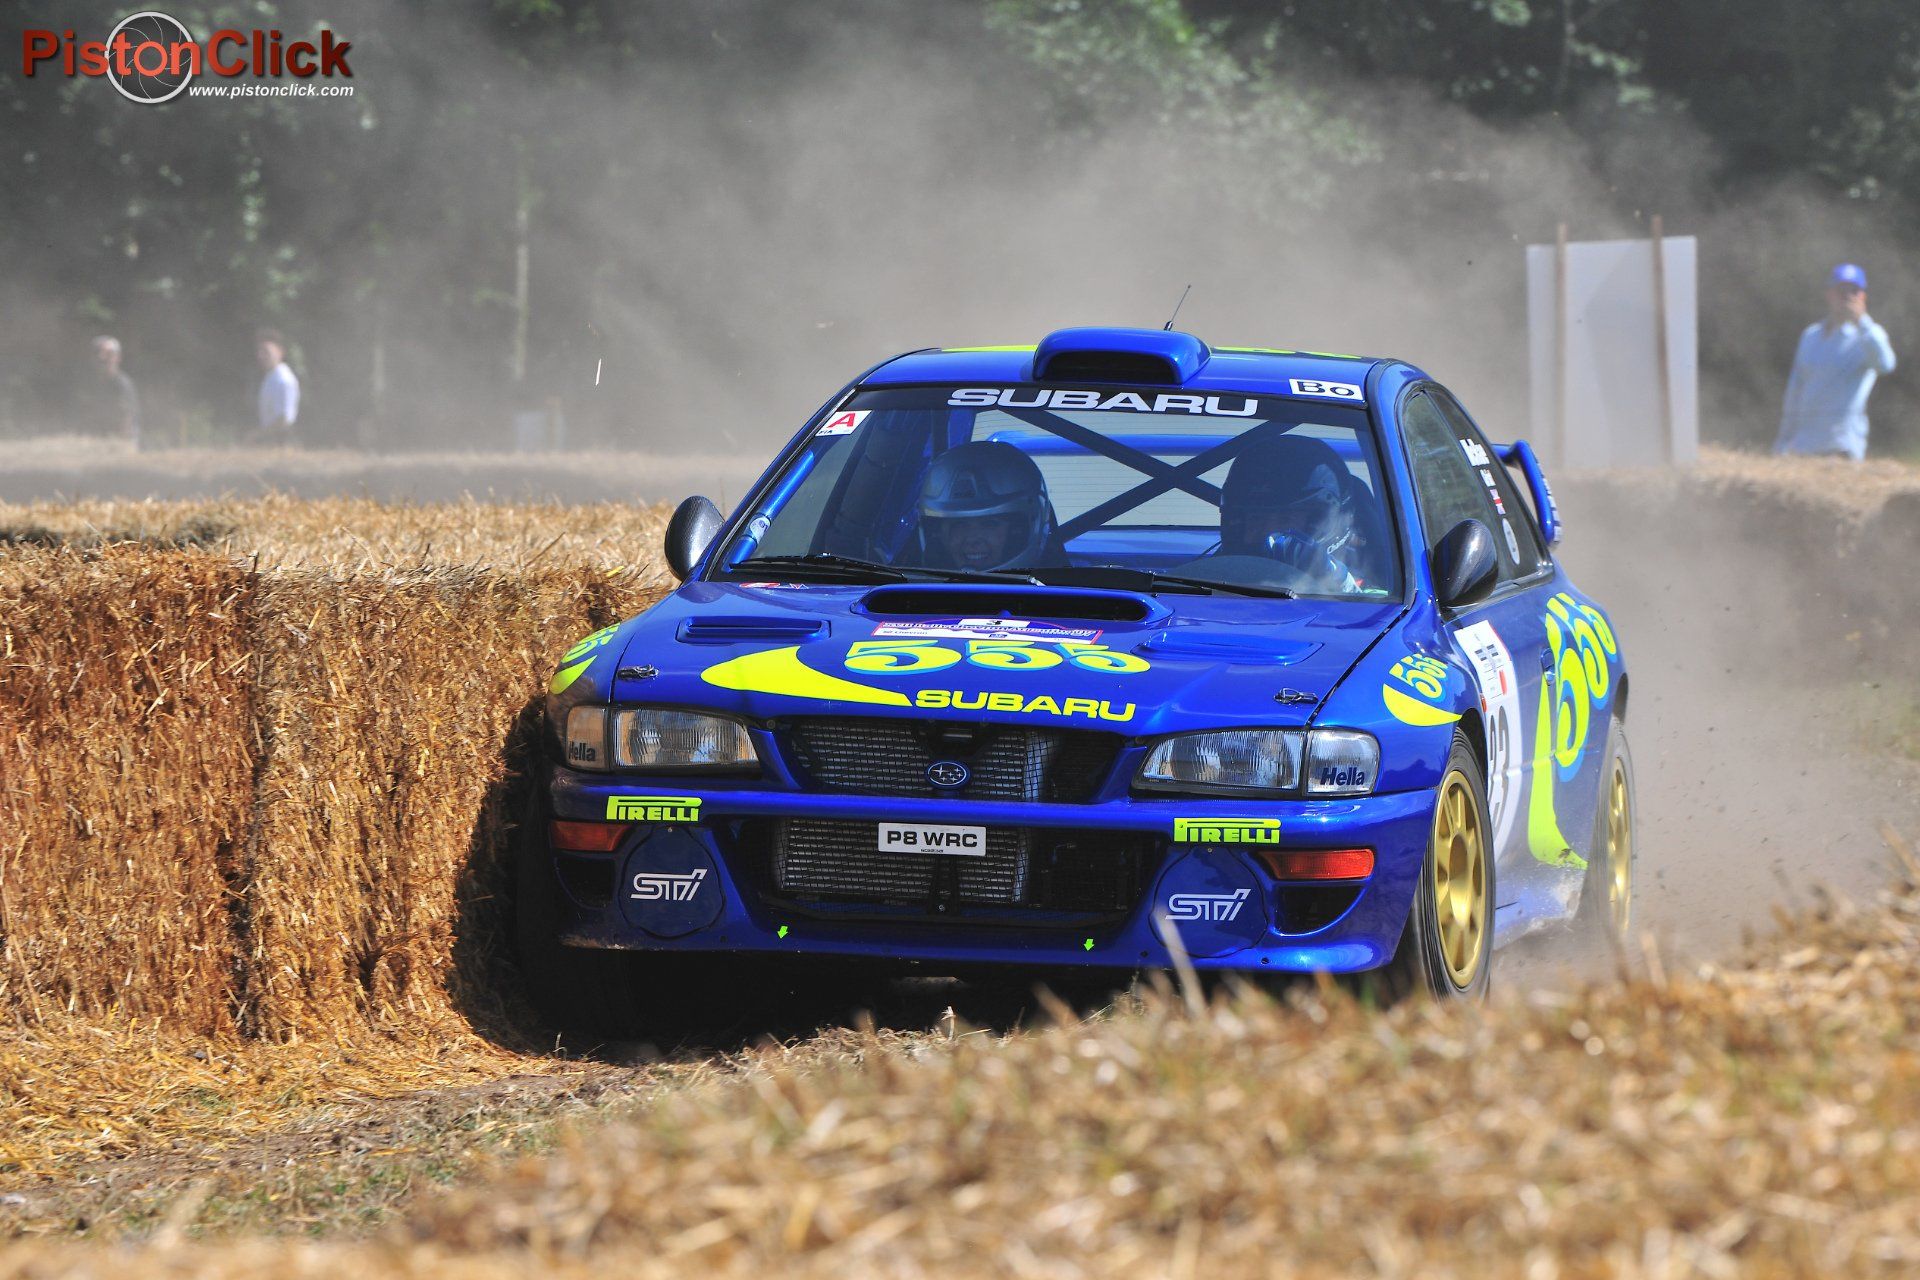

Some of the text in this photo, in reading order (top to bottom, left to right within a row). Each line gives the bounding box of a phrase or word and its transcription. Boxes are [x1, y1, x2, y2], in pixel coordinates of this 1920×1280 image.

[947, 388, 1258, 416] SUBARU
[826, 412, 856, 428] A
[844, 639, 1151, 674] 555
[914, 689, 1136, 722] SUBARU
[568, 741, 596, 761] Hella
[1320, 767, 1365, 787] Hella
[606, 796, 703, 821] PIRELLI
[887, 830, 978, 848] P8 WRC
[1173, 817, 1282, 844] PIRELLI
